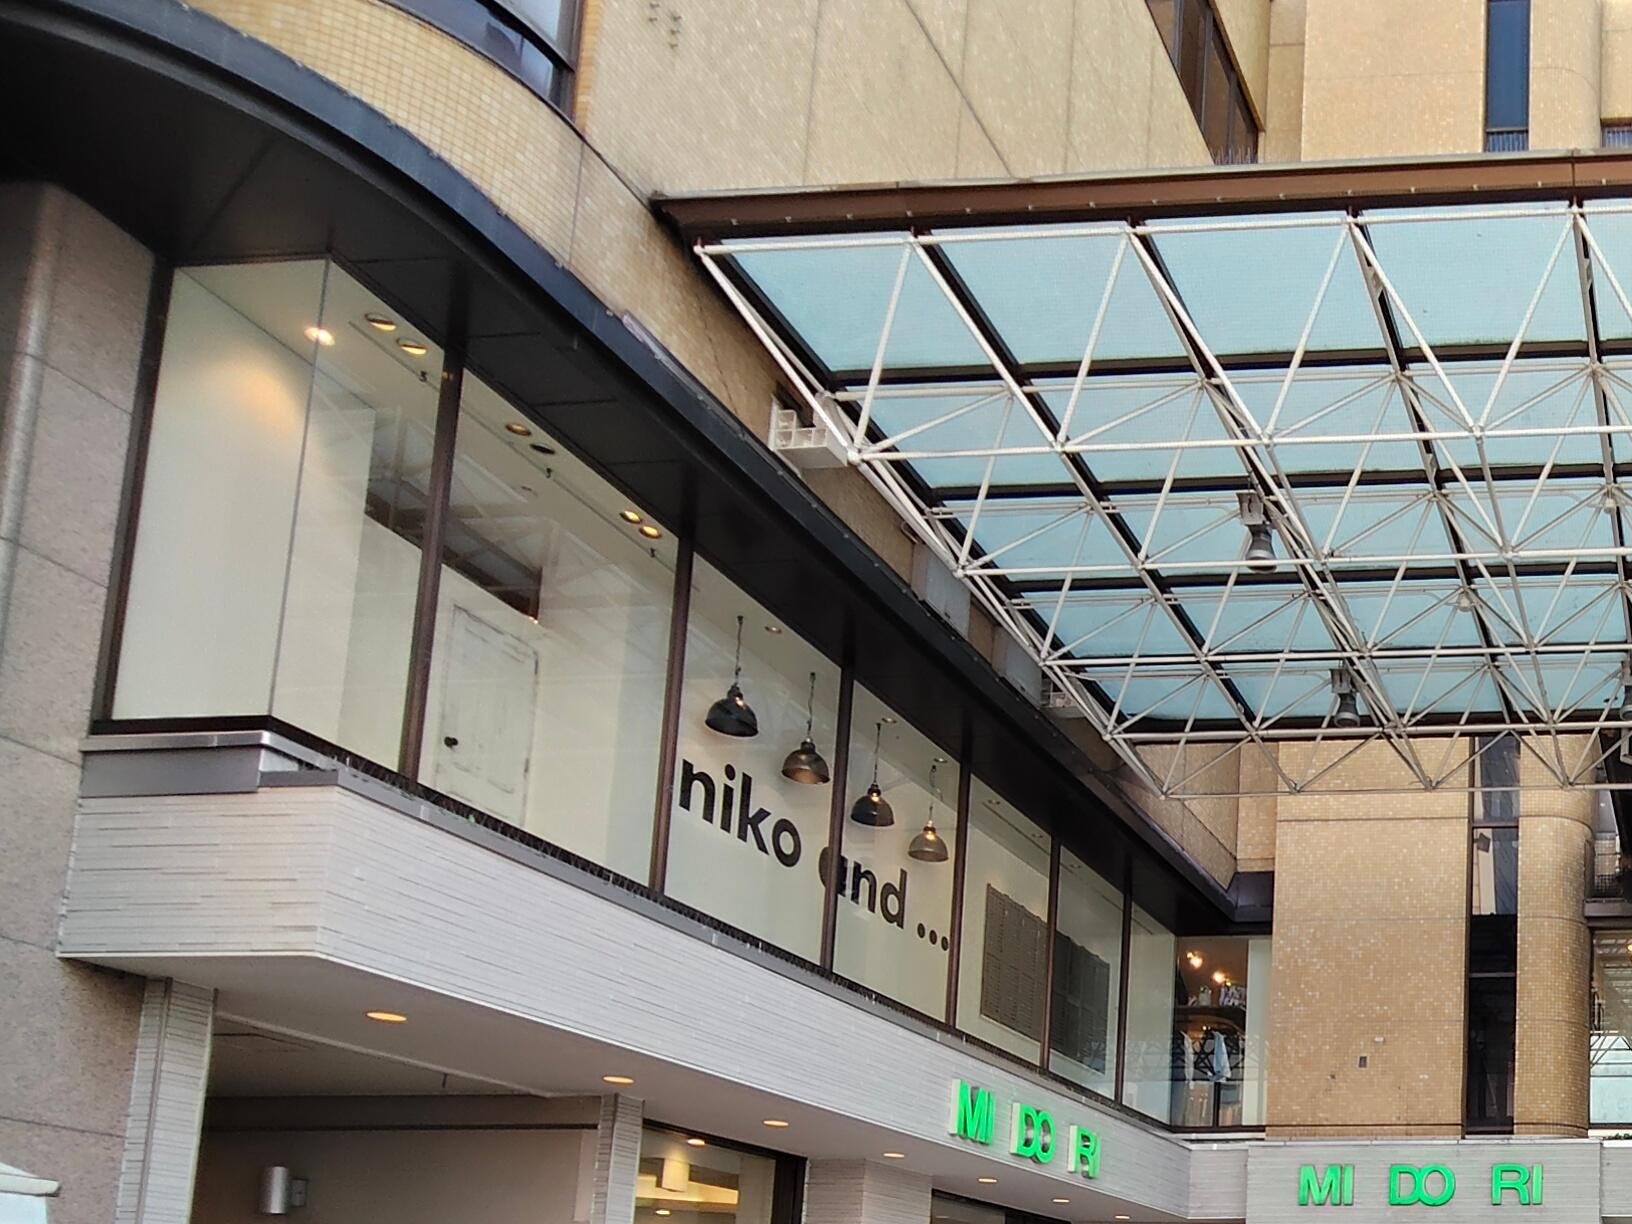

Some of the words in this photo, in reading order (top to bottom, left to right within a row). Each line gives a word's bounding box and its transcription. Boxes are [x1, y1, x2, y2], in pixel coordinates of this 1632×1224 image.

[679, 759, 802, 867] niko
[818, 846, 908, 929] and
[948, 1079, 996, 1145] MI
[1010, 1102, 1057, 1163] DO
[1298, 1164, 1354, 1206] MI
[1389, 1163, 1457, 1206] DO
[1491, 1163, 1543, 1205] RI
